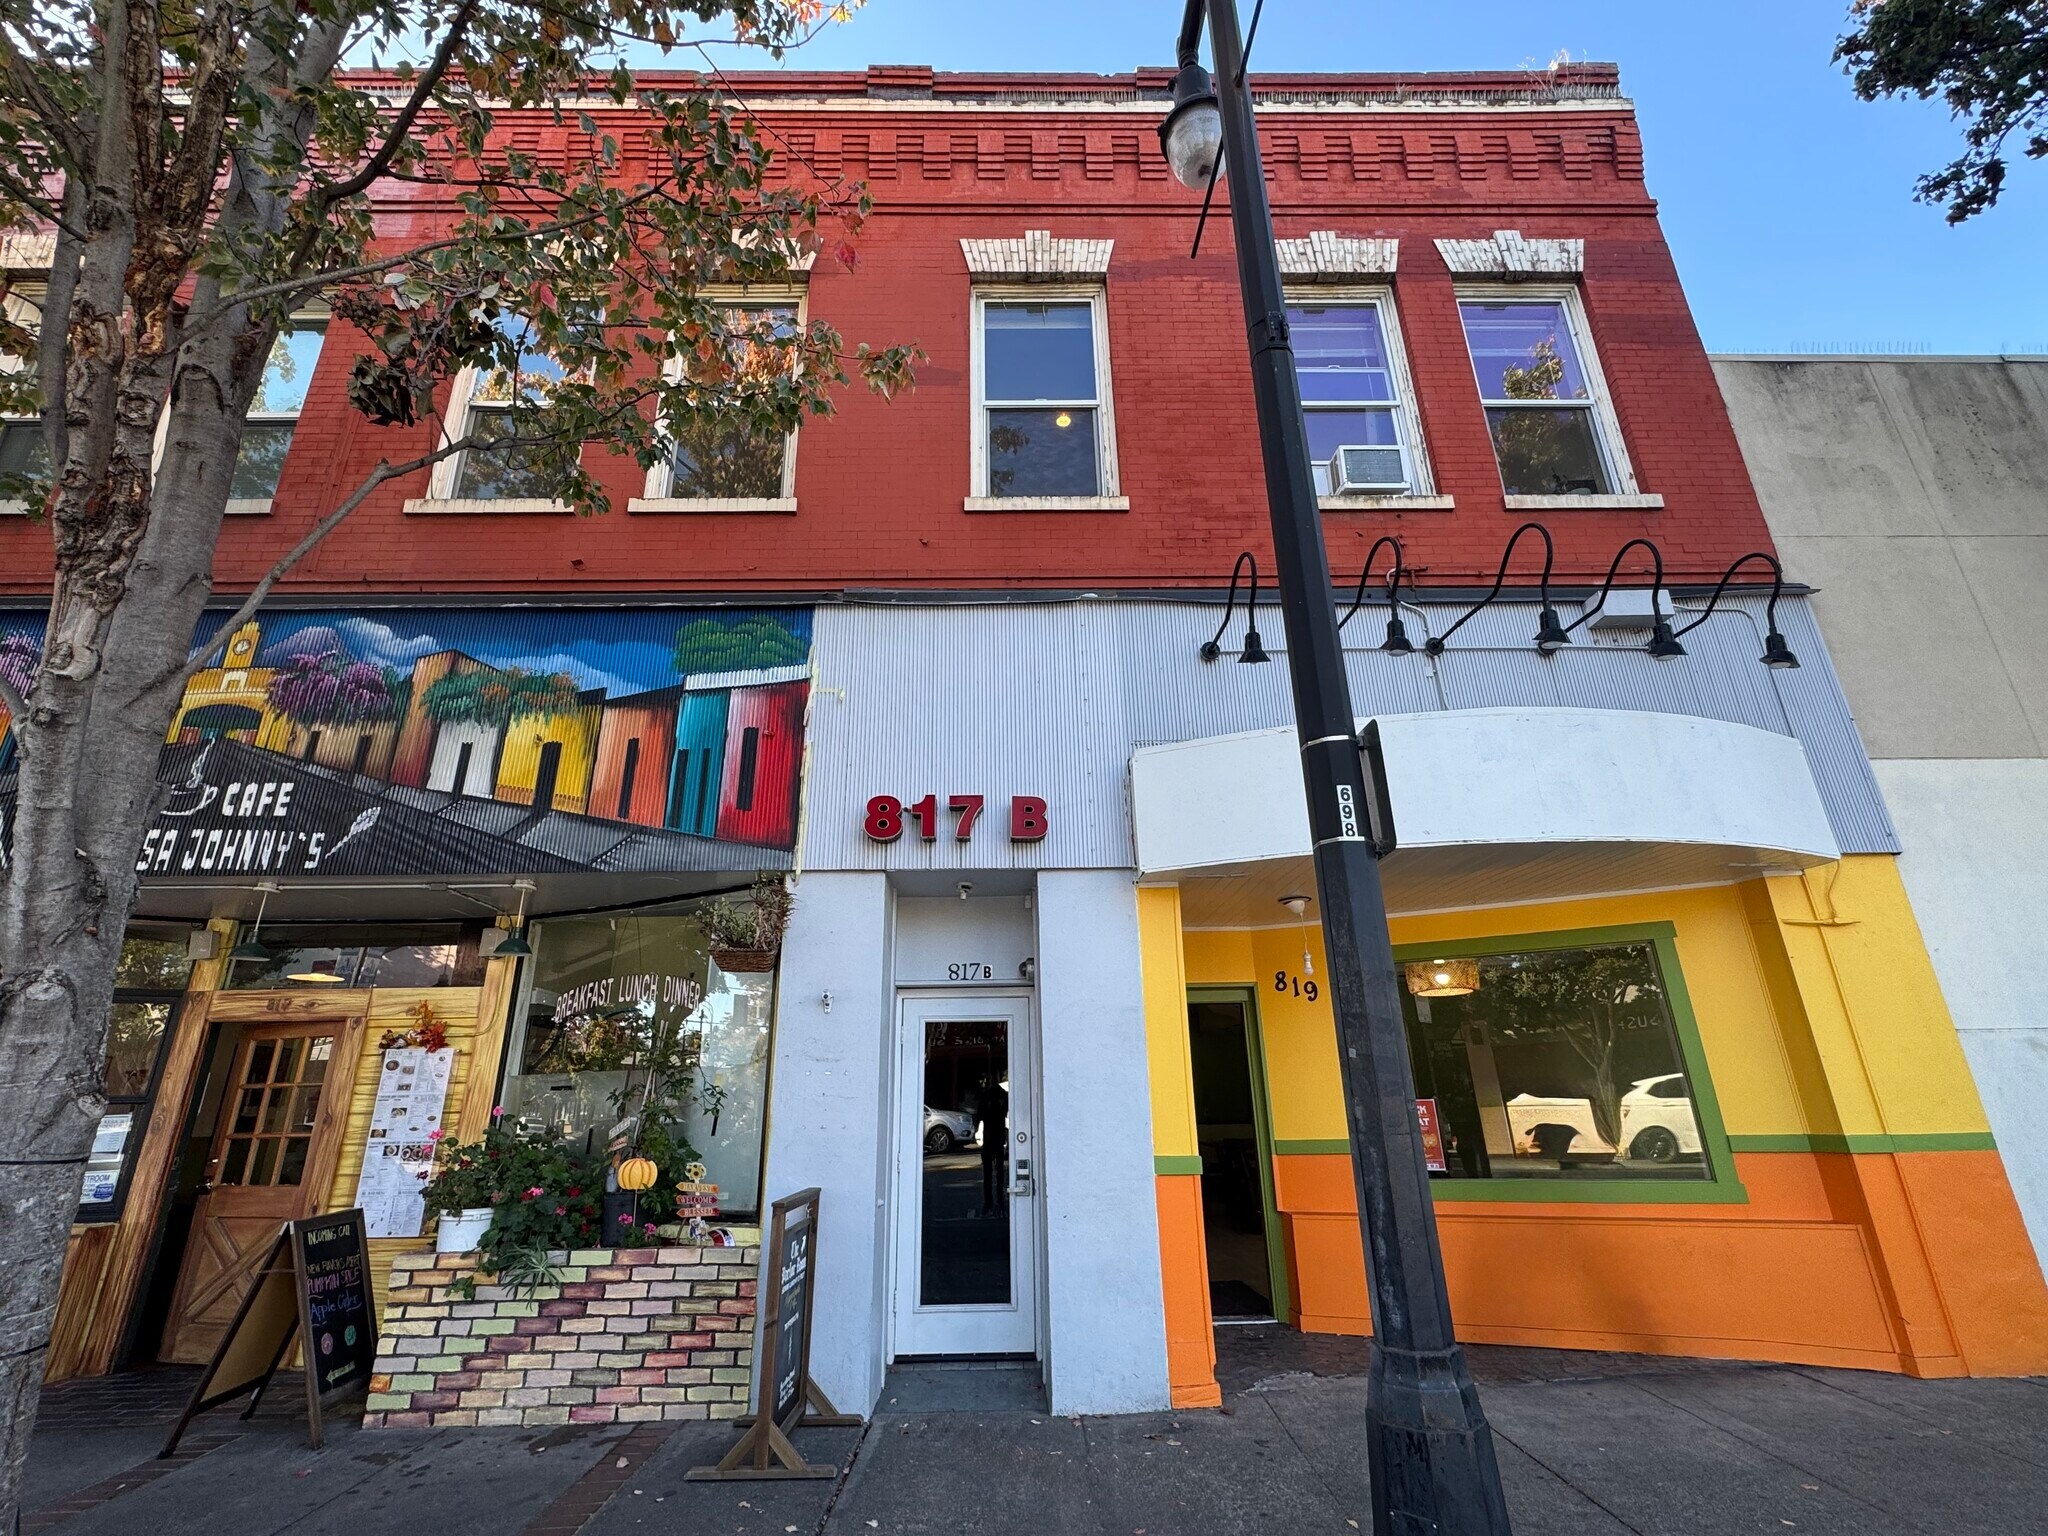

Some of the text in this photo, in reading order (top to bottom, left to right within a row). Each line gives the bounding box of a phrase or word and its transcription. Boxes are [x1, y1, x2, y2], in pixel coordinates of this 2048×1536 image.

[221, 782, 294, 817] CAFE
[863, 794, 1049, 842] 817 B
[1340, 787, 1356, 837] 698
[136, 829, 325, 871] SA JOHNNY'S
[554, 972, 701, 1020] BREAKFAST LUNCH DINNER
[1274, 970, 1318, 1002] 819
[83, 1174, 110, 1183] STROOM
[684, 1183, 712, 1193] HARVEST
[680, 1195, 712, 1204] WELCOME
[684, 1207, 713, 1216] BLESSED
[308, 1229, 336, 1244] INCOMING
[306, 1272, 340, 1295] PUMPKIN
[311, 1299, 336, 1321] Apple
